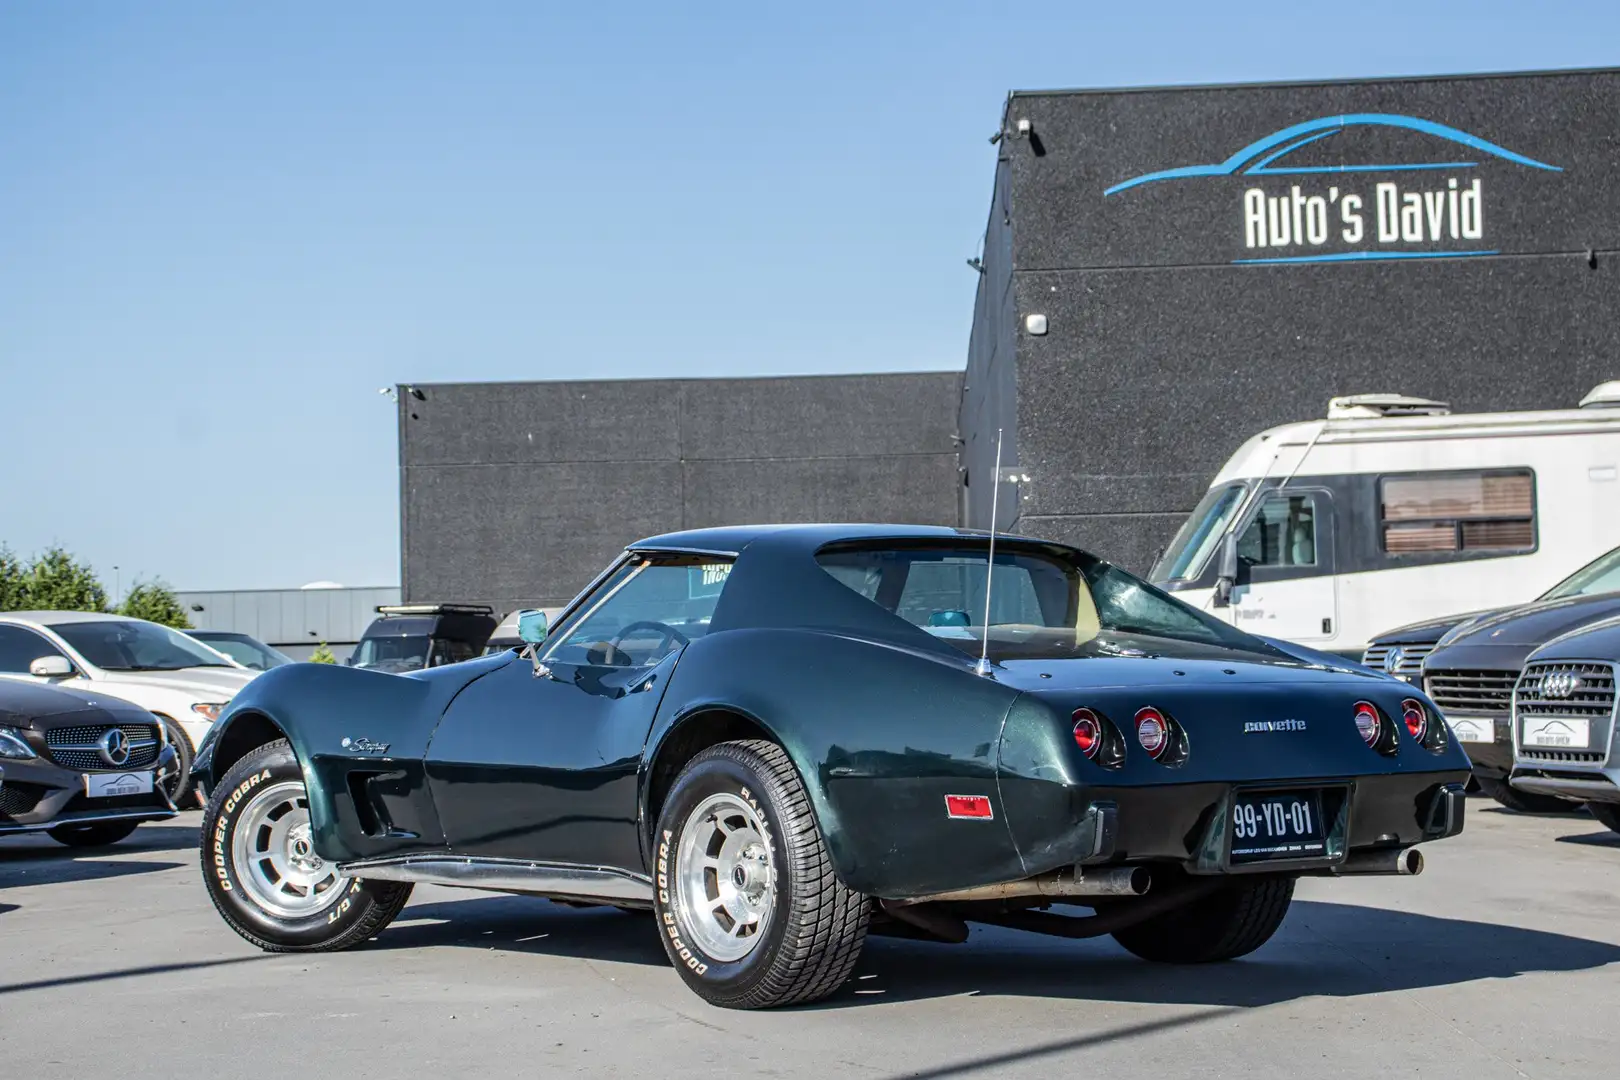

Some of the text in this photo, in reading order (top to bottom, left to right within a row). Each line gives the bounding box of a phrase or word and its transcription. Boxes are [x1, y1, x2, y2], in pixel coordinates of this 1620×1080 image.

[1244, 178, 1483, 248] Auto's David
[214, 769, 272, 891] COOPER COBRA
[1233, 801, 1313, 839] 99-YD-01
[328, 897, 351, 925] G/T
[658, 829, 708, 975] COOPER COBRA
